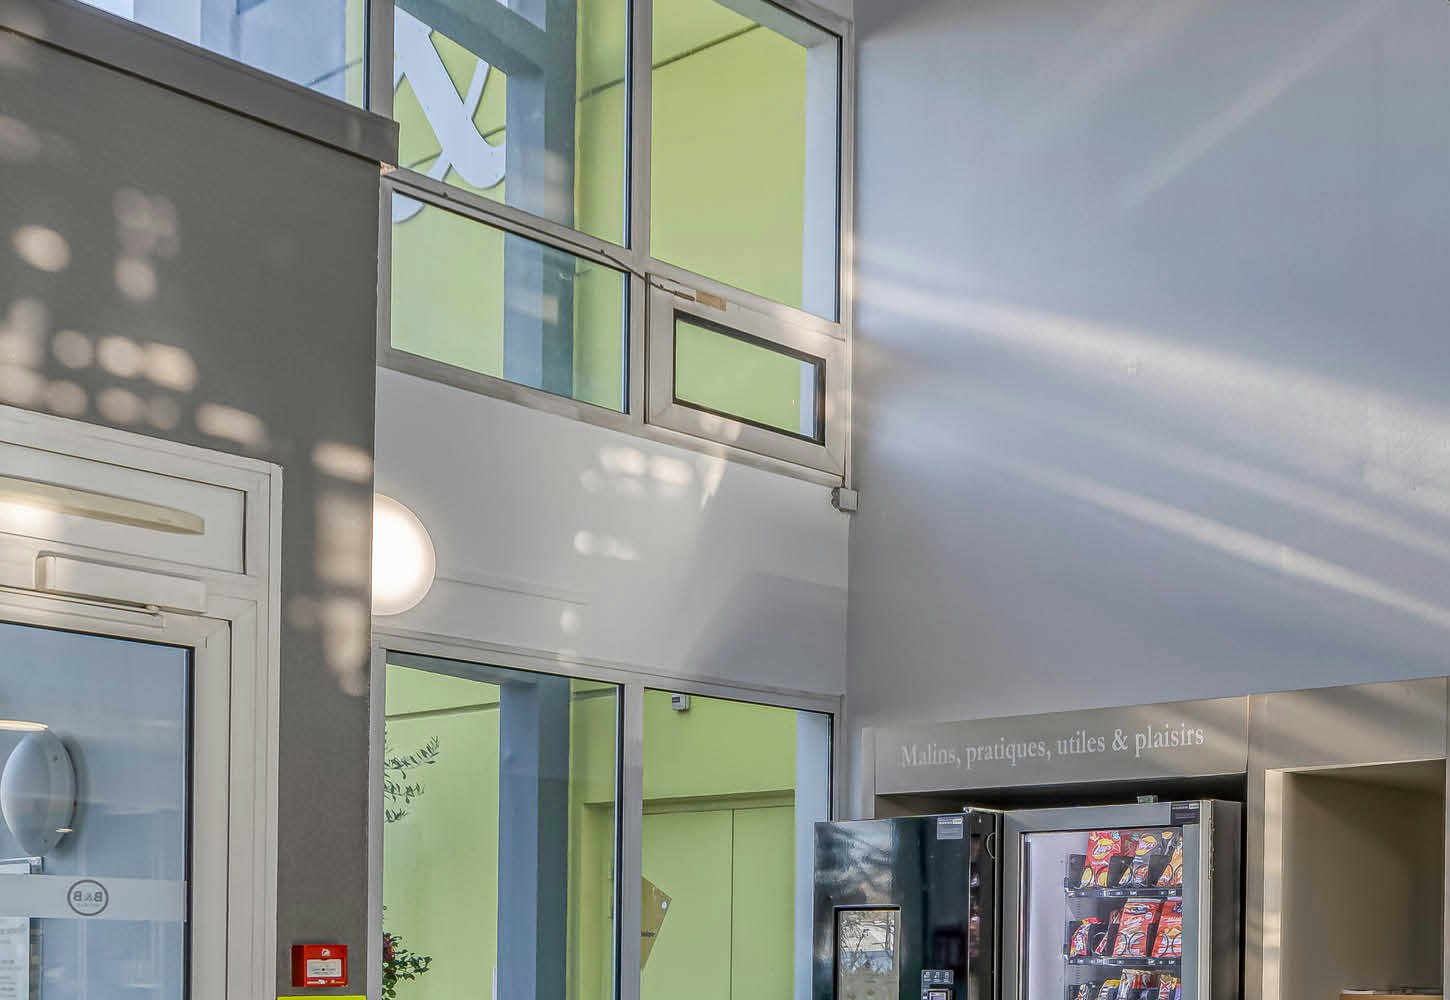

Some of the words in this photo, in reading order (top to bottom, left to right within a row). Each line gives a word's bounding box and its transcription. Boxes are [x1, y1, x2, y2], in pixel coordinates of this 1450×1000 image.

[901, 742, 962, 769] Malins,
[966, 737, 1052, 770] pratiques,
[1057, 730, 1106, 755] utiles
[1112, 728, 1128, 751] &
[1135, 723, 1205, 758] plaisirs
